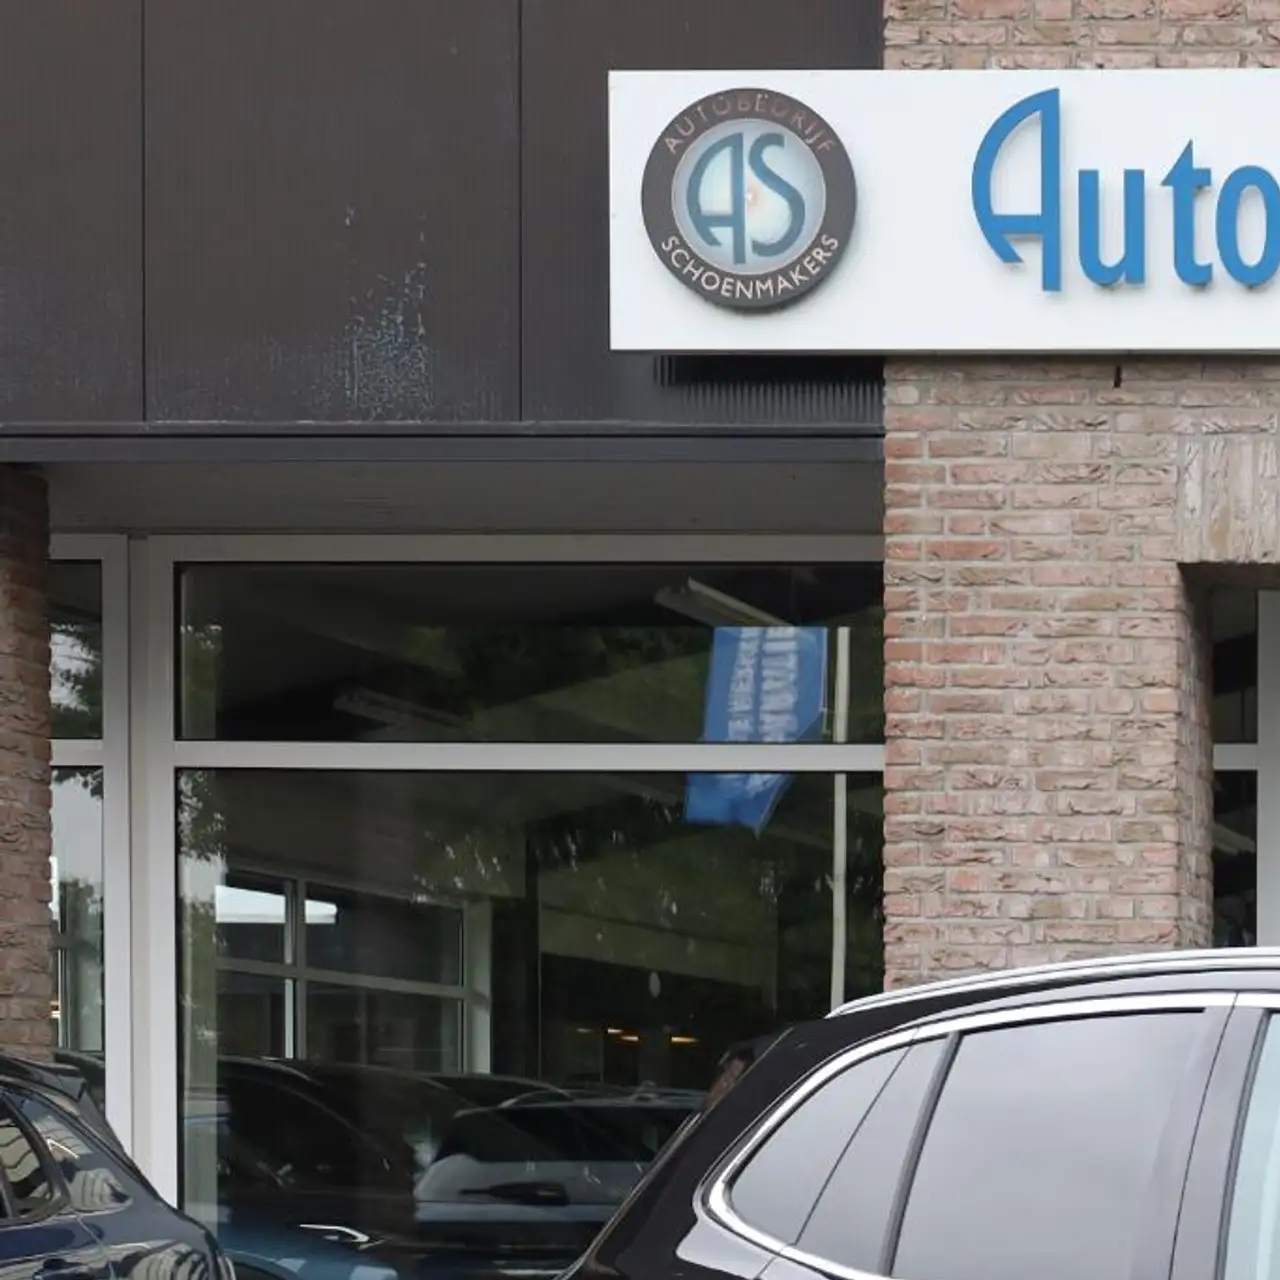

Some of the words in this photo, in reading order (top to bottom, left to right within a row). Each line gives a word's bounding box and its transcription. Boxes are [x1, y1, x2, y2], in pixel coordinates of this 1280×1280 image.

[664, 93, 837, 154] AUTOBEDRIJF
[686, 132, 806, 265] AS
[661, 233, 839, 300] SCHOENMAKERS
